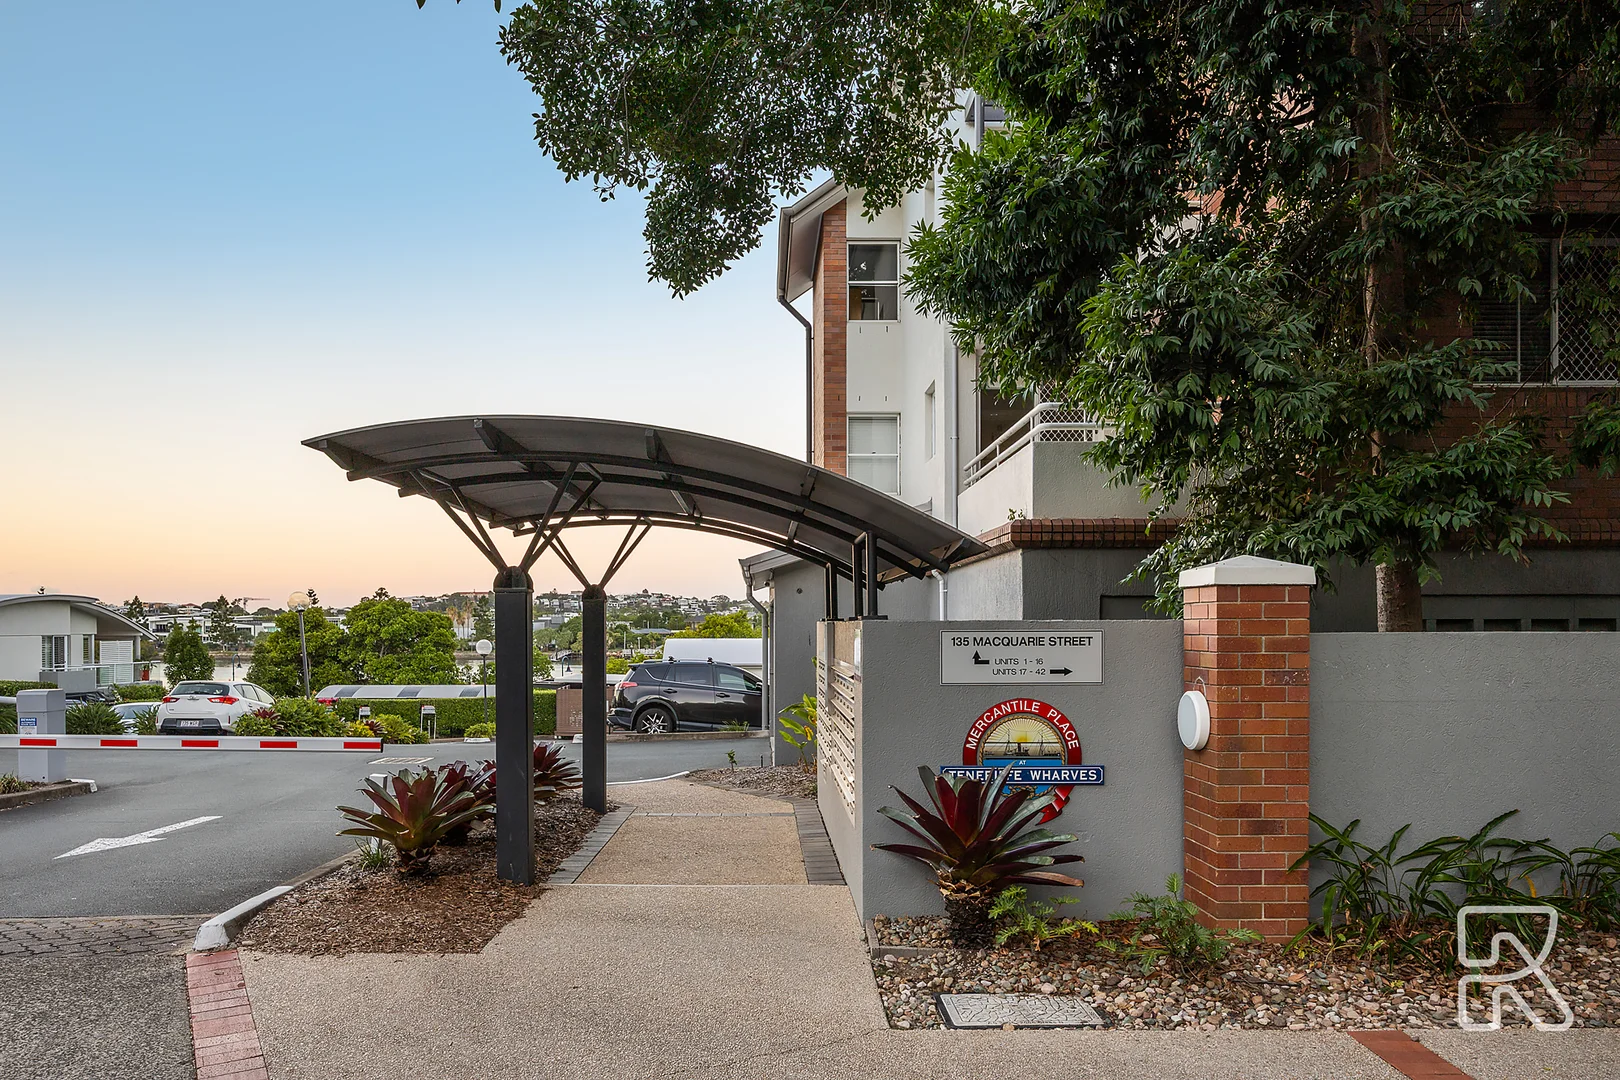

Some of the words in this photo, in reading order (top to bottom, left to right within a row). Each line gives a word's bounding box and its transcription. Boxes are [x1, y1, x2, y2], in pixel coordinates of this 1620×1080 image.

[951, 636, 970, 647] 135
[973, 636, 1046, 647] MACQUARIE
[1048, 636, 1094, 647] STREET
[994, 658, 1019, 666] UNITS
[1035, 658, 1044, 666] 16
[992, 668, 1017, 676] UNITS
[1019, 668, 1028, 676] 17
[1035, 668, 1046, 676] 42
[966, 700, 1041, 750] MERCANTILE
[1047, 709, 1079, 750] PLACE
[1029, 770, 1098, 781] WHARVES
